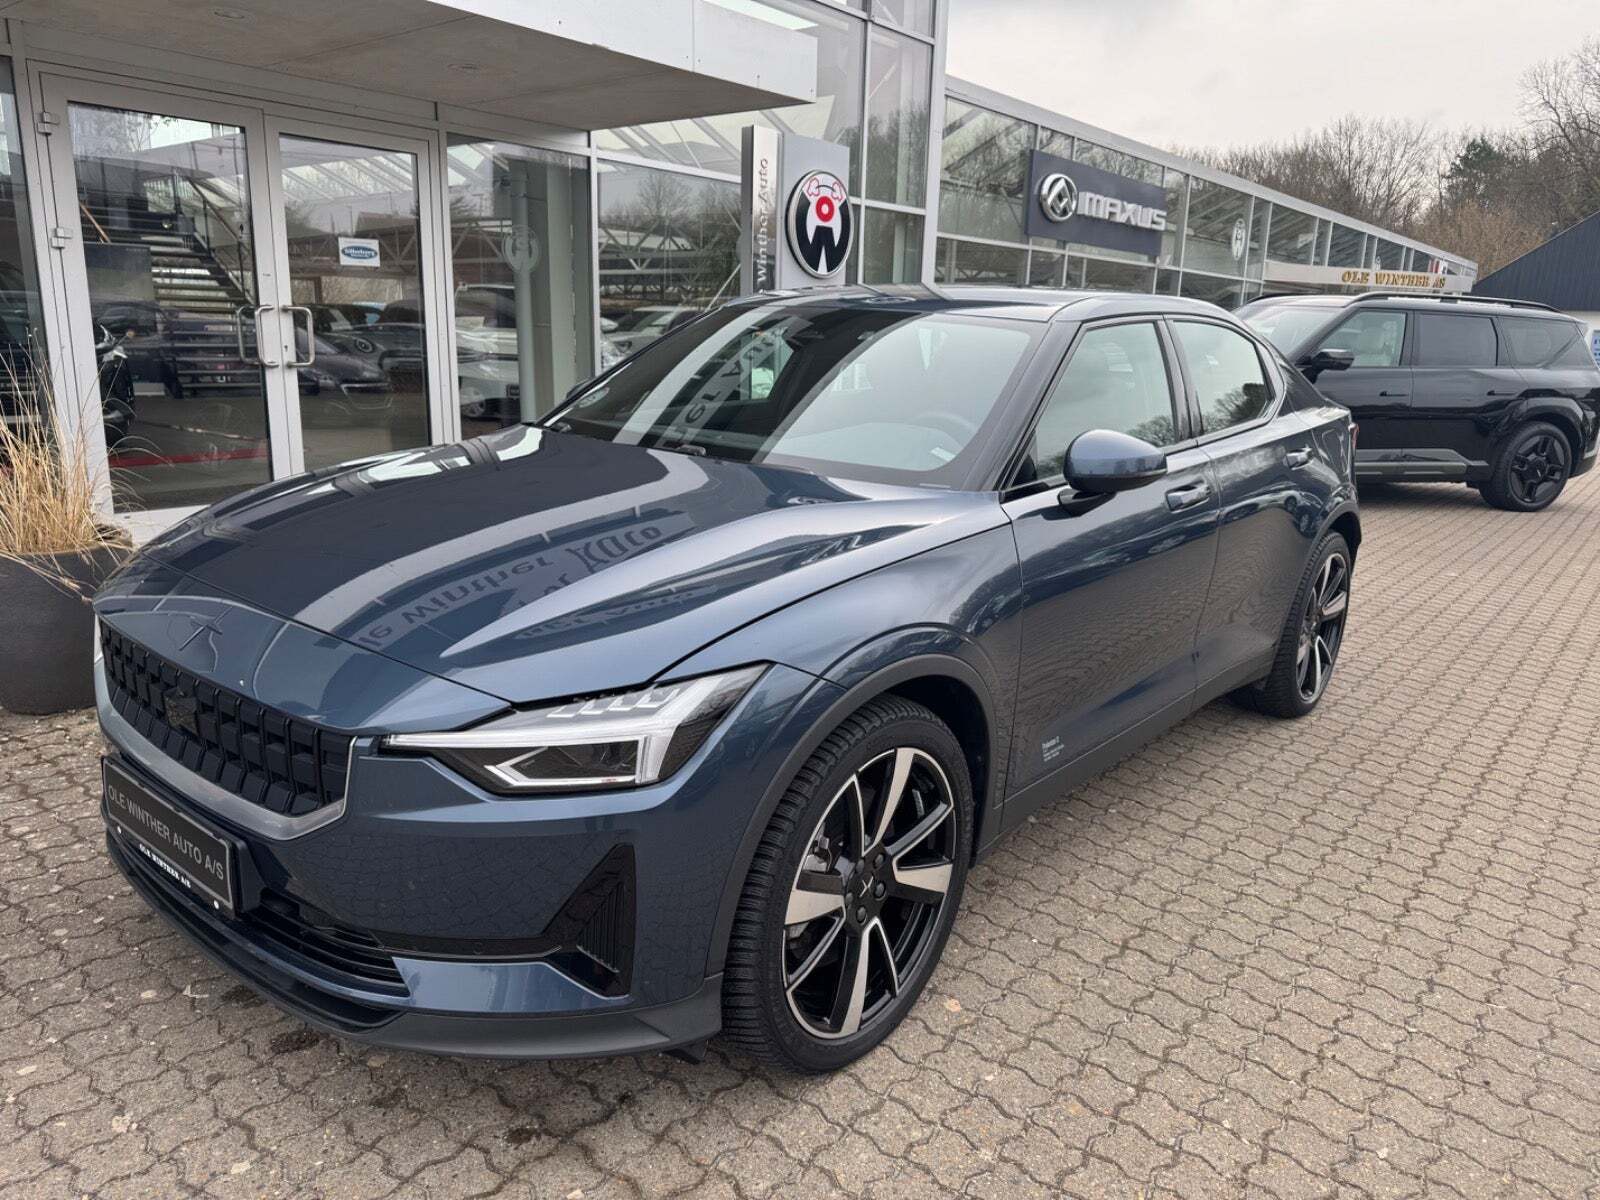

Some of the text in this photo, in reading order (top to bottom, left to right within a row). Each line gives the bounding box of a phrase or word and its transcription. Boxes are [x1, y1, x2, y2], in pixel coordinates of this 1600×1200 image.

[1077, 191, 1167, 231] MAXUS
[1341, 270, 1369, 283] OLE
[1375, 271, 1430, 288] WINTHER
[108, 785, 224, 881] OLE WINTHER AUTO A/S
[151, 852, 180, 881] WINTHER
